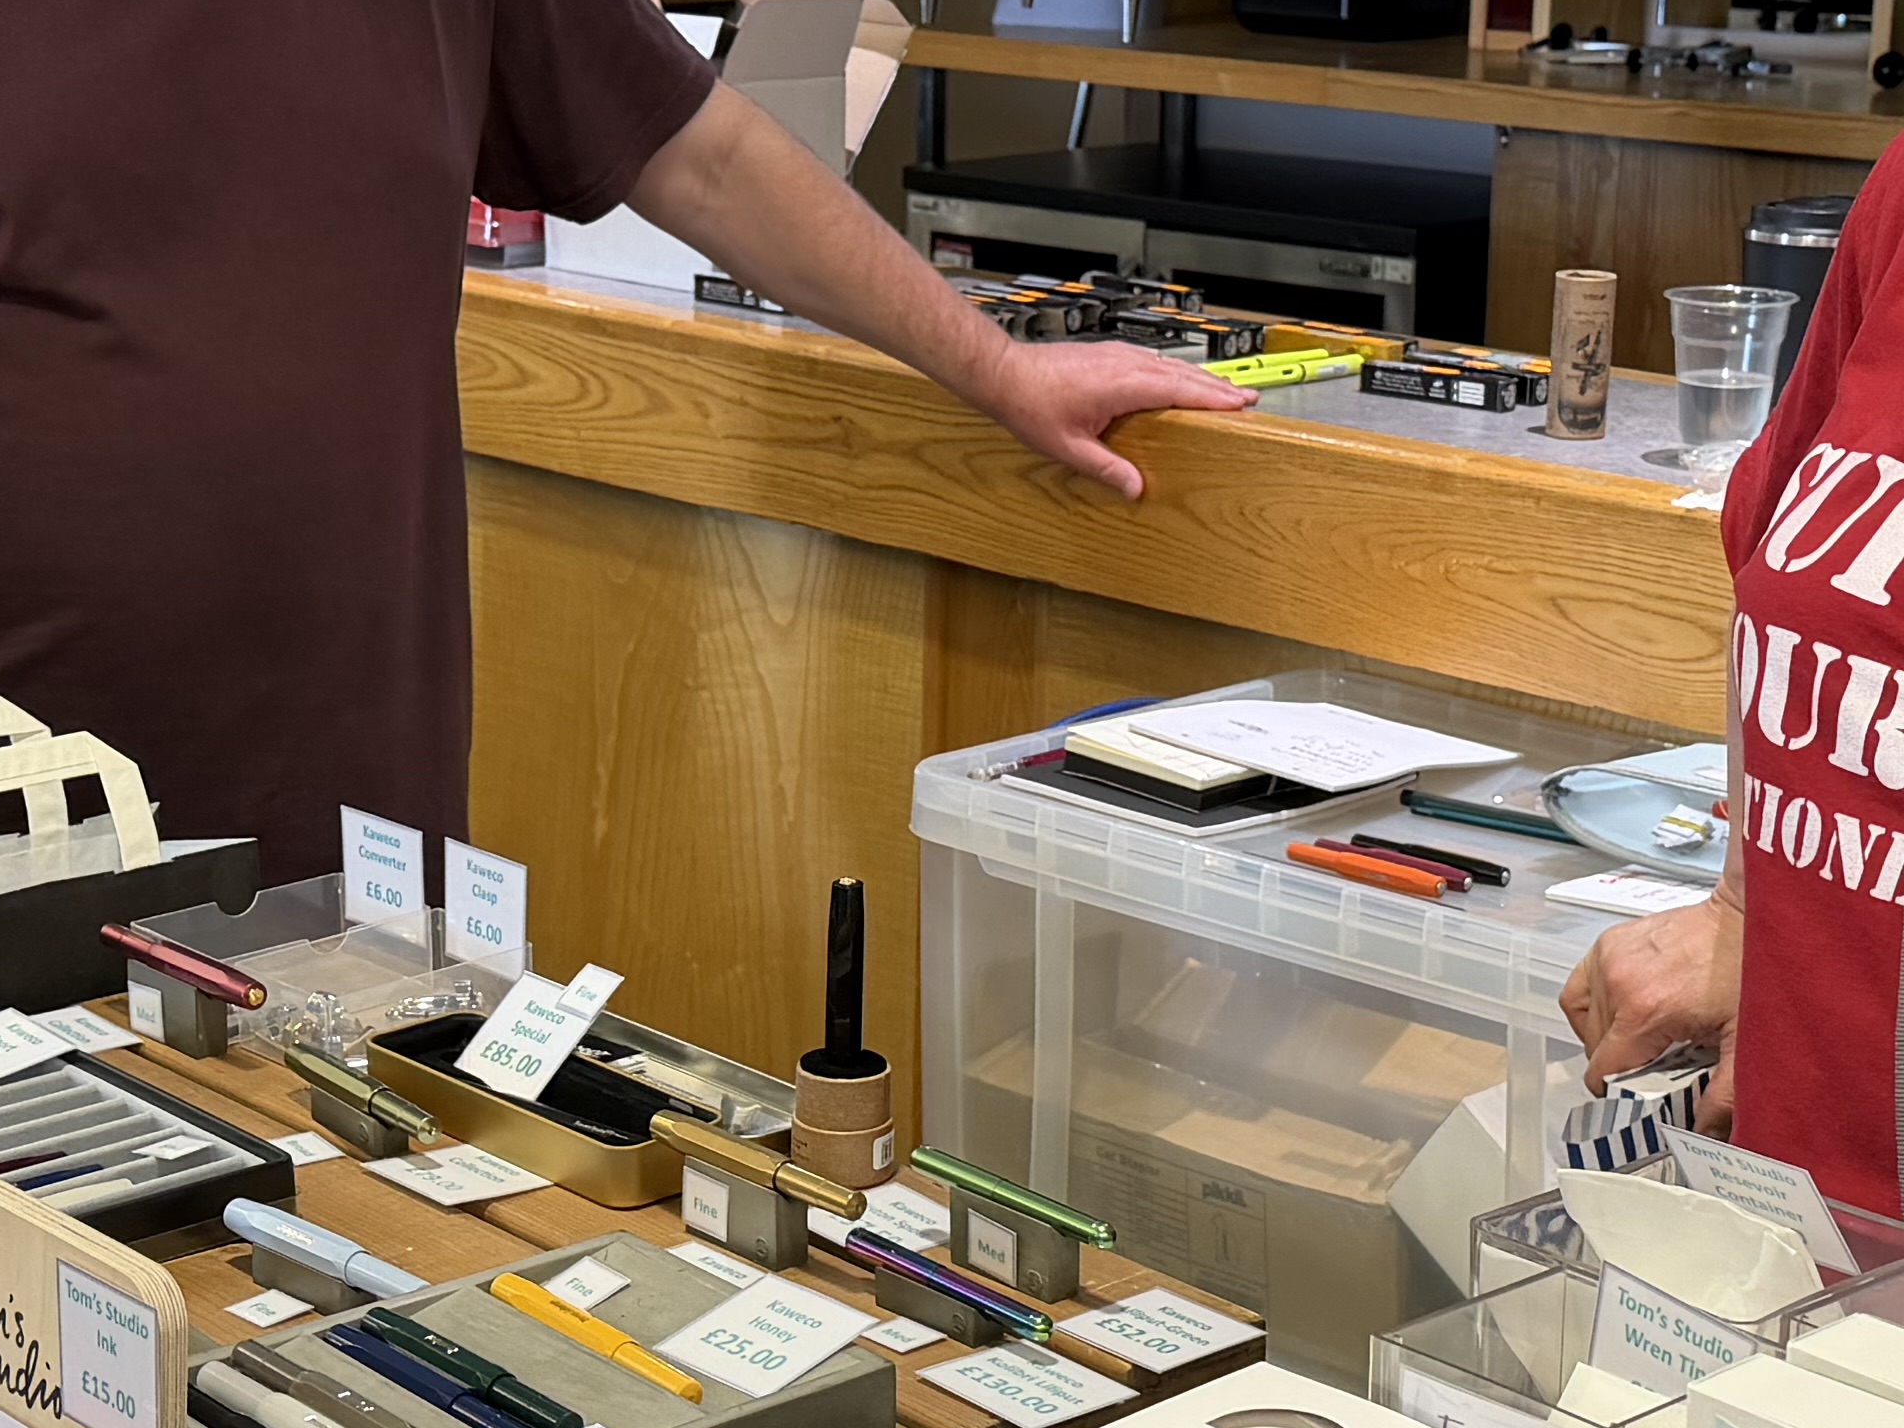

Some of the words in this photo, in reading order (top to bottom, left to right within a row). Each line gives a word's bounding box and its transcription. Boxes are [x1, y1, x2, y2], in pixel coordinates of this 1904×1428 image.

[362, 824, 401, 849] Kaweco
[358, 844, 407, 872] Converter
[466, 858, 505, 884] Kaweco
[365, 881, 403, 908] £6.00
[472, 883, 498, 906] Clasp
[466, 916, 503, 945] £6.00
[524, 999, 566, 1026] Kaweco
[511, 1019, 552, 1046] Special
[479, 1039, 543, 1079] £85.00
[1711, 1167, 1788, 1201] Resevoir
[1736, 1154, 1797, 1188] Studio
[693, 1197, 718, 1220] Fine
[564, 1276, 594, 1298] Fine
[65, 1278, 103, 1316] Tom's
[105, 1301, 149, 1340] Studio
[766, 1299, 823, 1330] Kaweco
[748, 1315, 798, 1344] Honey
[1094, 1317, 1182, 1355] £52.00
[1617, 1286, 1671, 1334] Tom's
[1673, 1313, 1734, 1365] Studio
[96, 1329, 117, 1357] Ink
[700, 1328, 788, 1371] £25.00
[81, 1369, 136, 1420] £15.00
[955, 1364, 1059, 1416] £130.00
